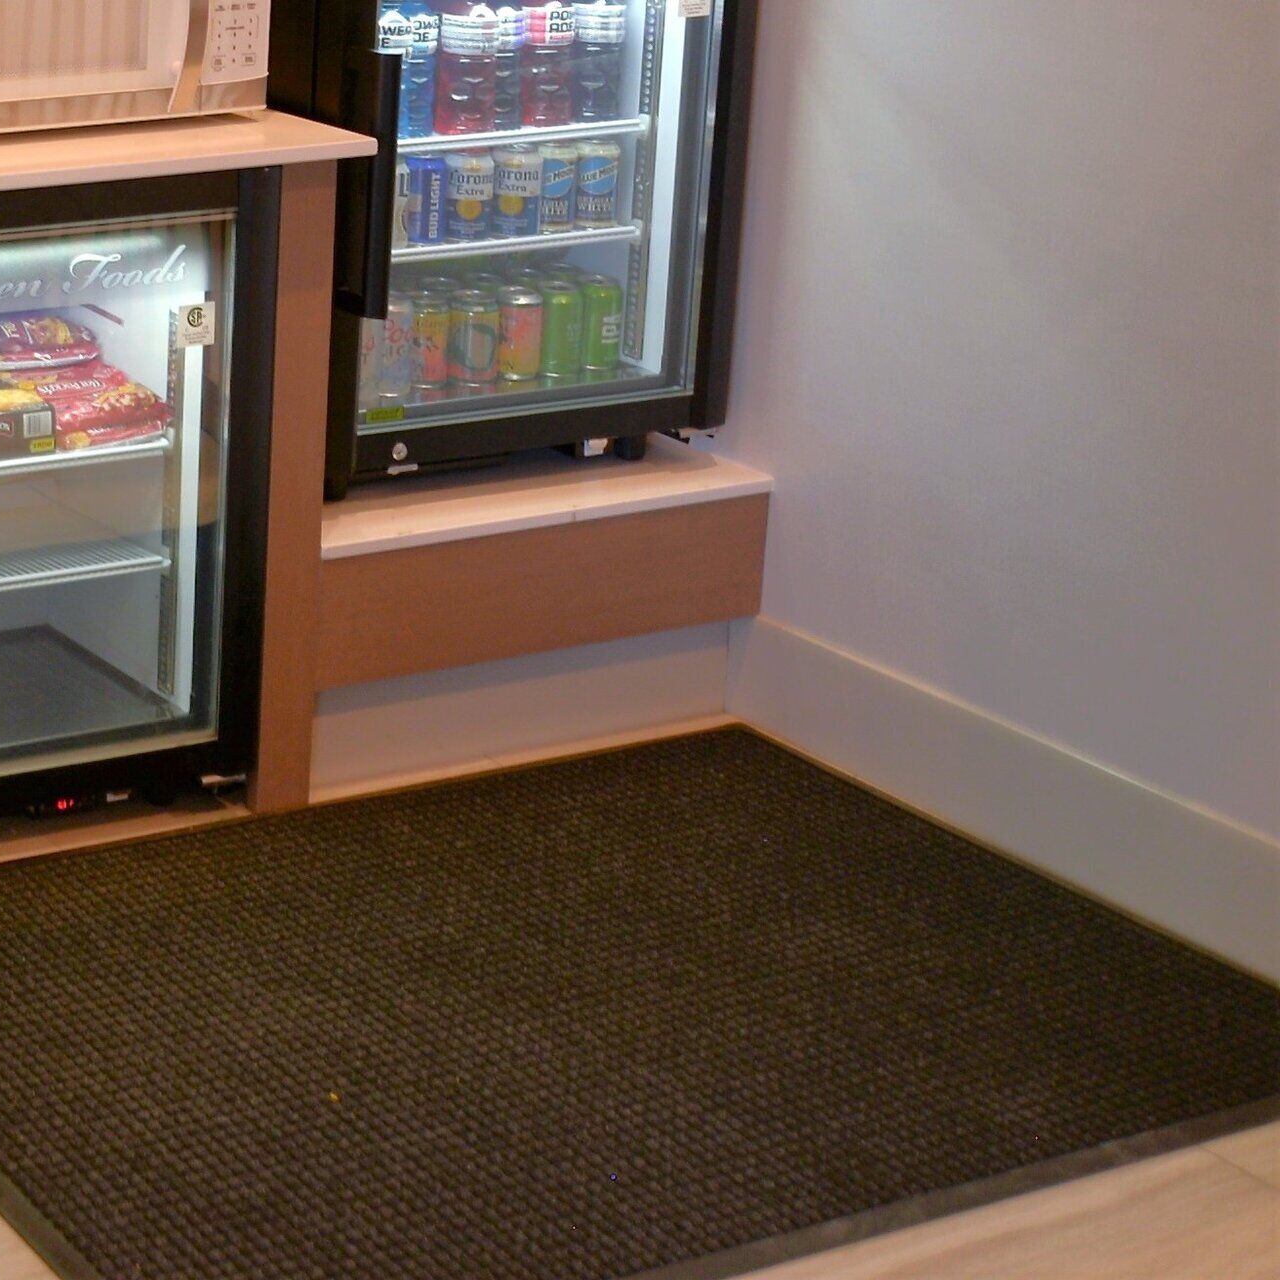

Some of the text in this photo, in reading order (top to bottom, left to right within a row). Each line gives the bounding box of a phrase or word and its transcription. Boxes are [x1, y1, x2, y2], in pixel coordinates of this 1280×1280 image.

[382, 26, 411, 36] WER
[494, 169, 538, 182] orona
[430, 173, 441, 209] LIGHT
[456, 186, 484, 195] Extra
[498, 184, 527, 192] Extra
[62, 244, 188, 294] Foods
